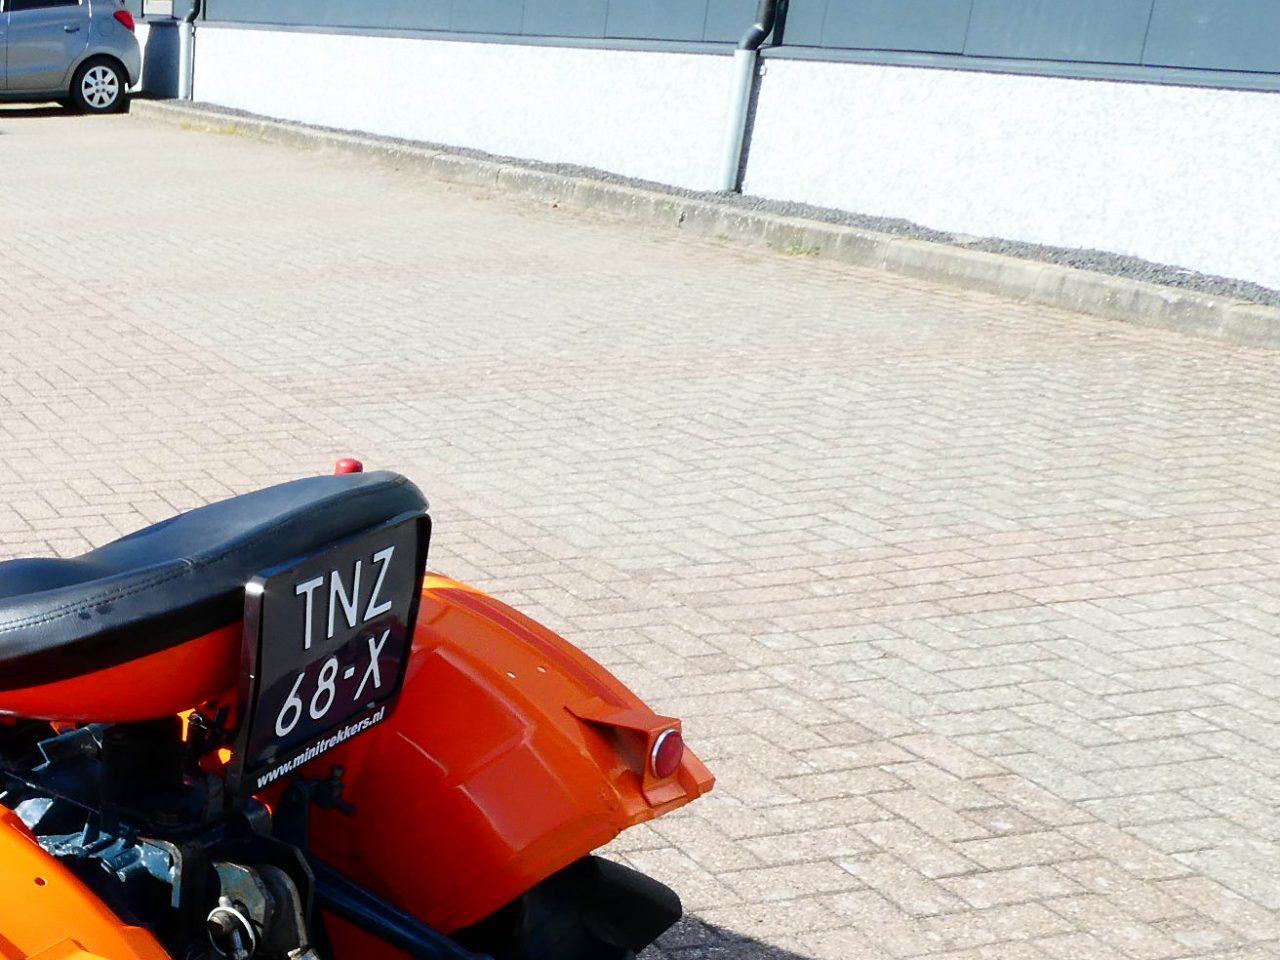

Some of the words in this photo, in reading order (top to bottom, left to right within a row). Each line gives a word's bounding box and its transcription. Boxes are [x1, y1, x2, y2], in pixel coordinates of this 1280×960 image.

[295, 545, 395, 650] TNZ
[275, 629, 391, 737] 68-X
[257, 706, 385, 789] www.minitrekkers.nl
